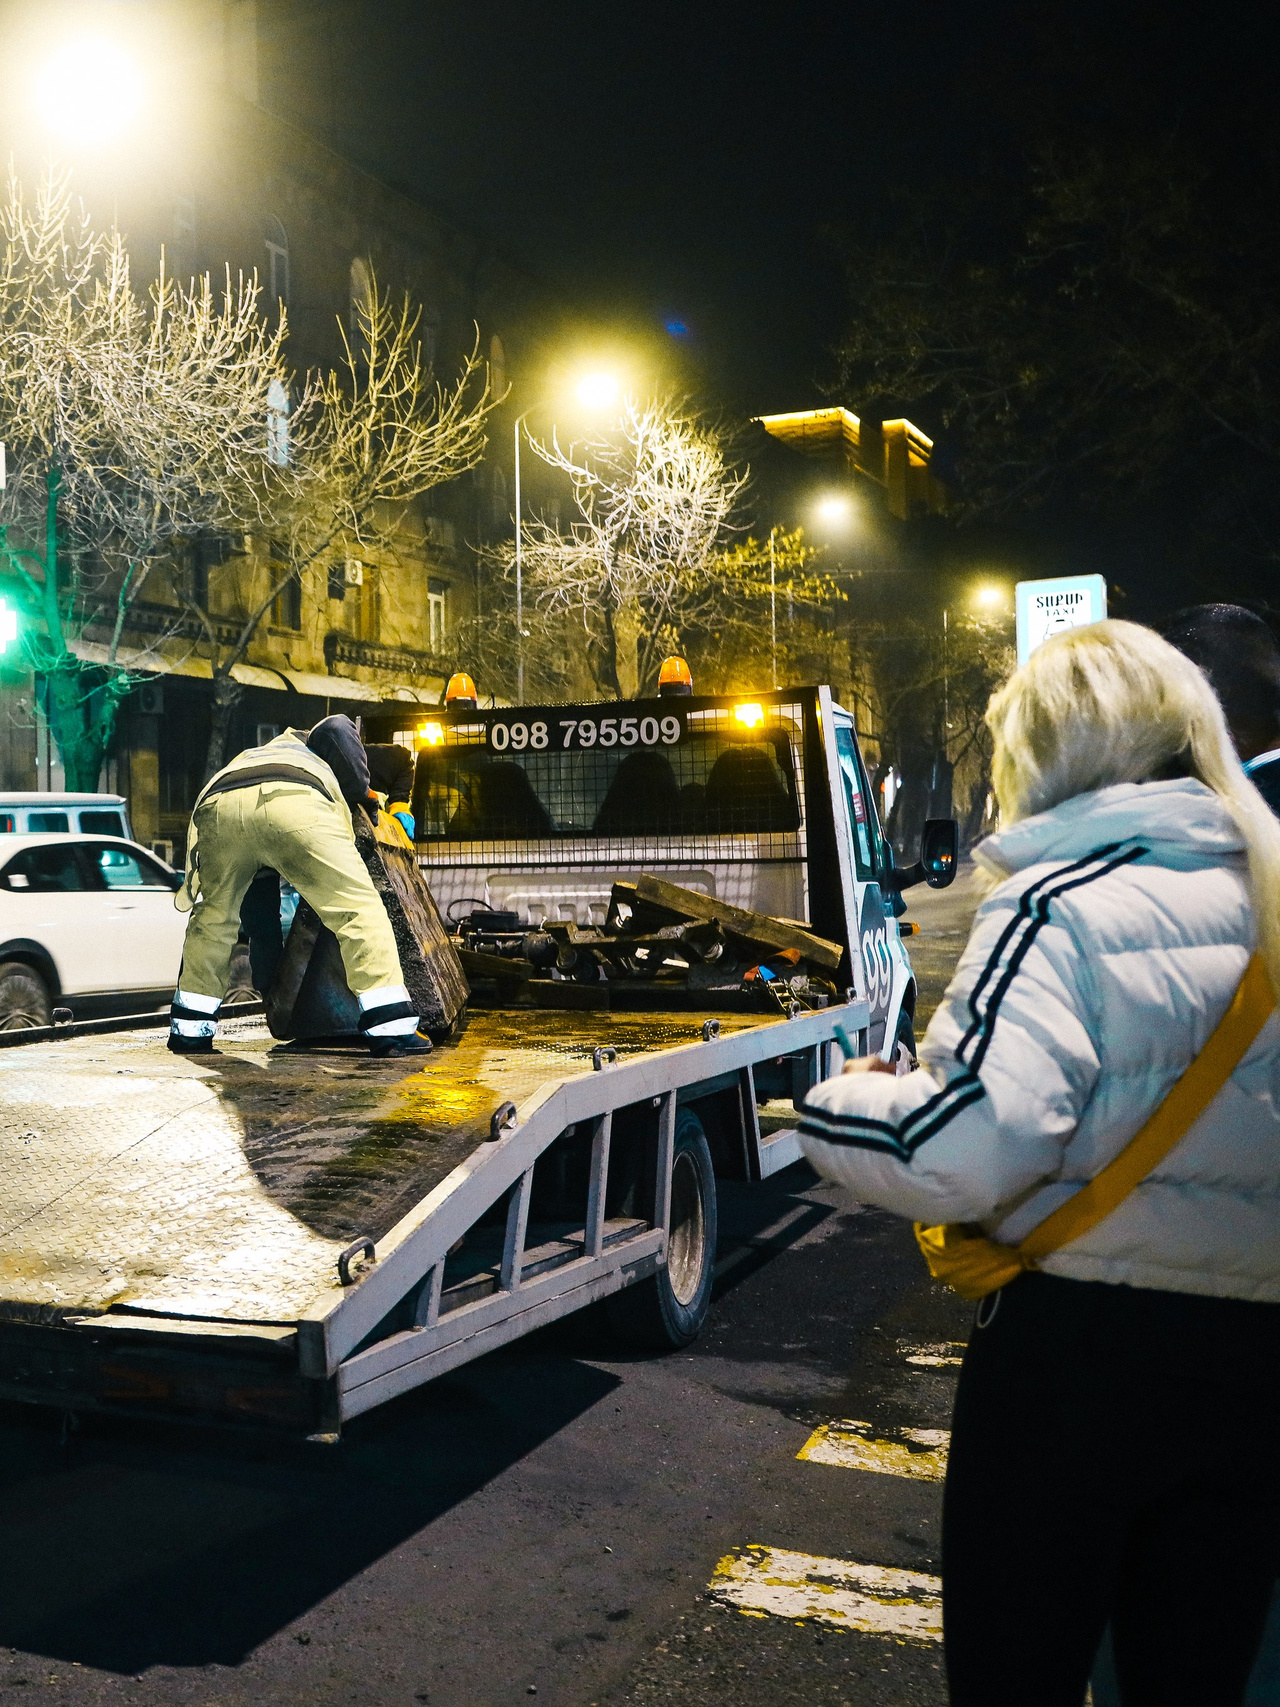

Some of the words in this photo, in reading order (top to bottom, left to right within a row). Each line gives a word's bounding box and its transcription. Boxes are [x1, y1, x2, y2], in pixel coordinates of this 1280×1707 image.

[1046, 607, 1075, 616] TAXI
[491, 721, 549, 750] 098
[559, 716, 681, 748] 795509
